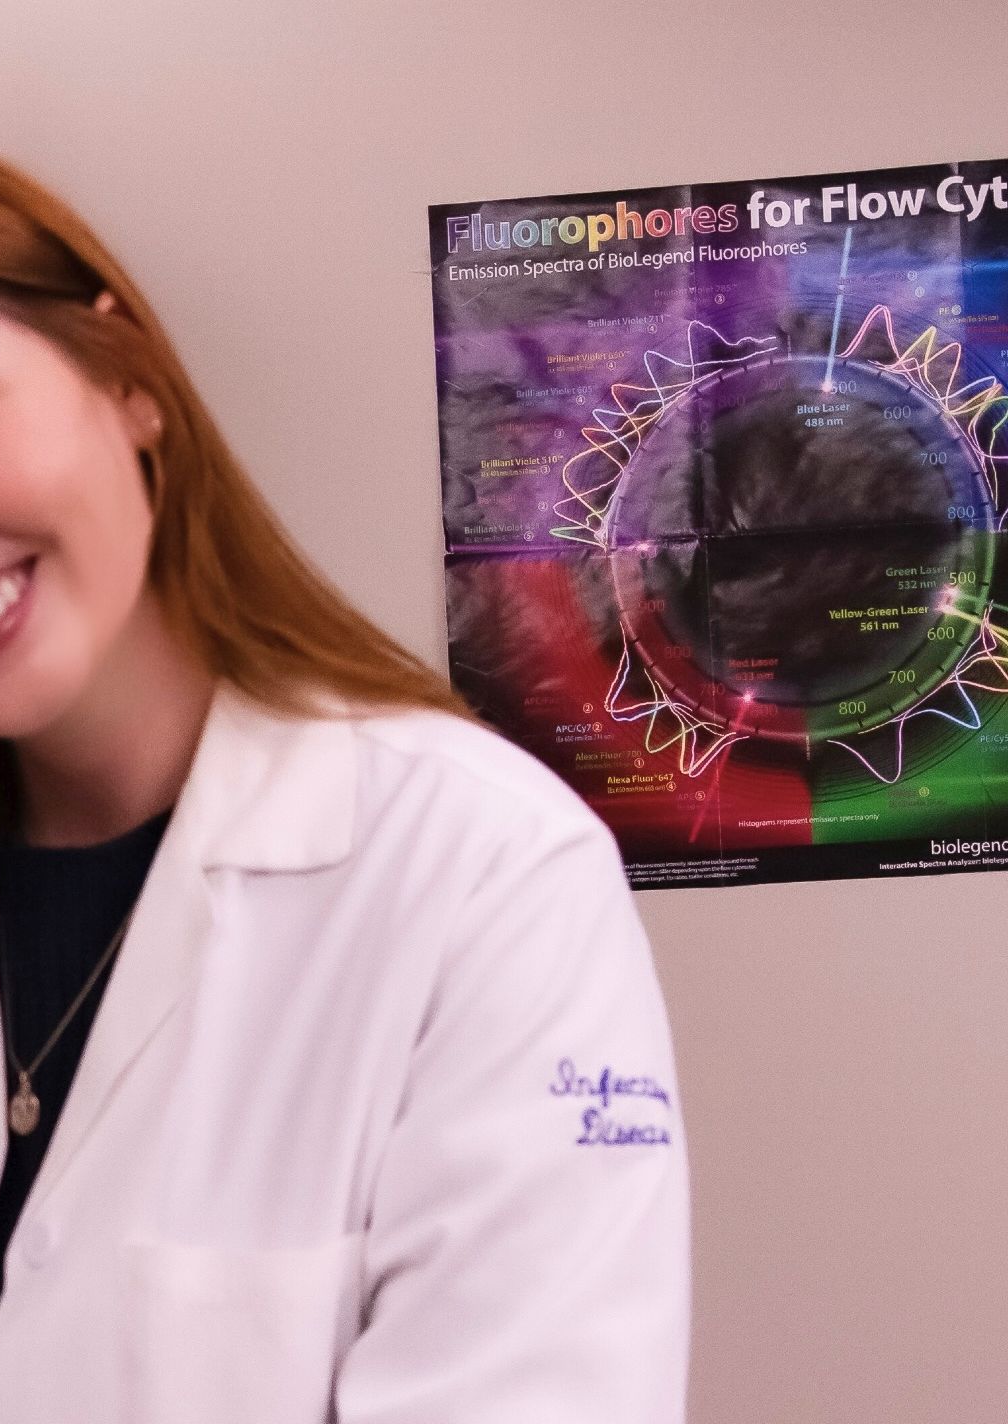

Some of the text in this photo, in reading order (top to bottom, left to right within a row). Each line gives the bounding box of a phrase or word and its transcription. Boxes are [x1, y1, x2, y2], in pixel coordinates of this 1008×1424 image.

[447, 175, 1008, 253] Fluorophores for Flow Cyt
[449, 239, 808, 281] Emission Spectra of BioLegend Fluorophores
[587, 317, 621, 328] Brilliant
[622, 315, 647, 326] Violet
[547, 353, 580, 364] Brilliant
[581, 351, 606, 362] Violet
[516, 387, 549, 398] Brilliant
[550, 386, 576, 397] Violet
[797, 402, 850, 415] Blue Laser
[883, 405, 911, 420] 600
[804, 416, 844, 427] 488 nm
[480, 458, 515, 469] Brilliant
[516, 457, 540, 467] Violet
[920, 451, 948, 466] 700
[947, 506, 975, 520] 800
[464, 525, 497, 535] Brilliant
[498, 524, 524, 534] Violet
[885, 565, 948, 577] Green Laser
[949, 571, 976, 585] 500
[898, 580, 937, 590] 532 nm
[829, 605, 930, 620] Yellow-Green Laser
[860, 622, 899, 632] 561 nm
[927, 626, 955, 641] 600
[888, 670, 916, 684] 700
[838, 701, 866, 715] 800
[555, 722, 592, 735] APC/Cy7
[607, 775, 631, 785] Alexa
[658, 772, 674, 782] 647
[738, 812, 880, 829] Histograms represent emission spectra only
[879, 861, 918, 870] Interactive
[919, 859, 946, 869] Spectra
[947, 857, 981, 868] Analyzer:
